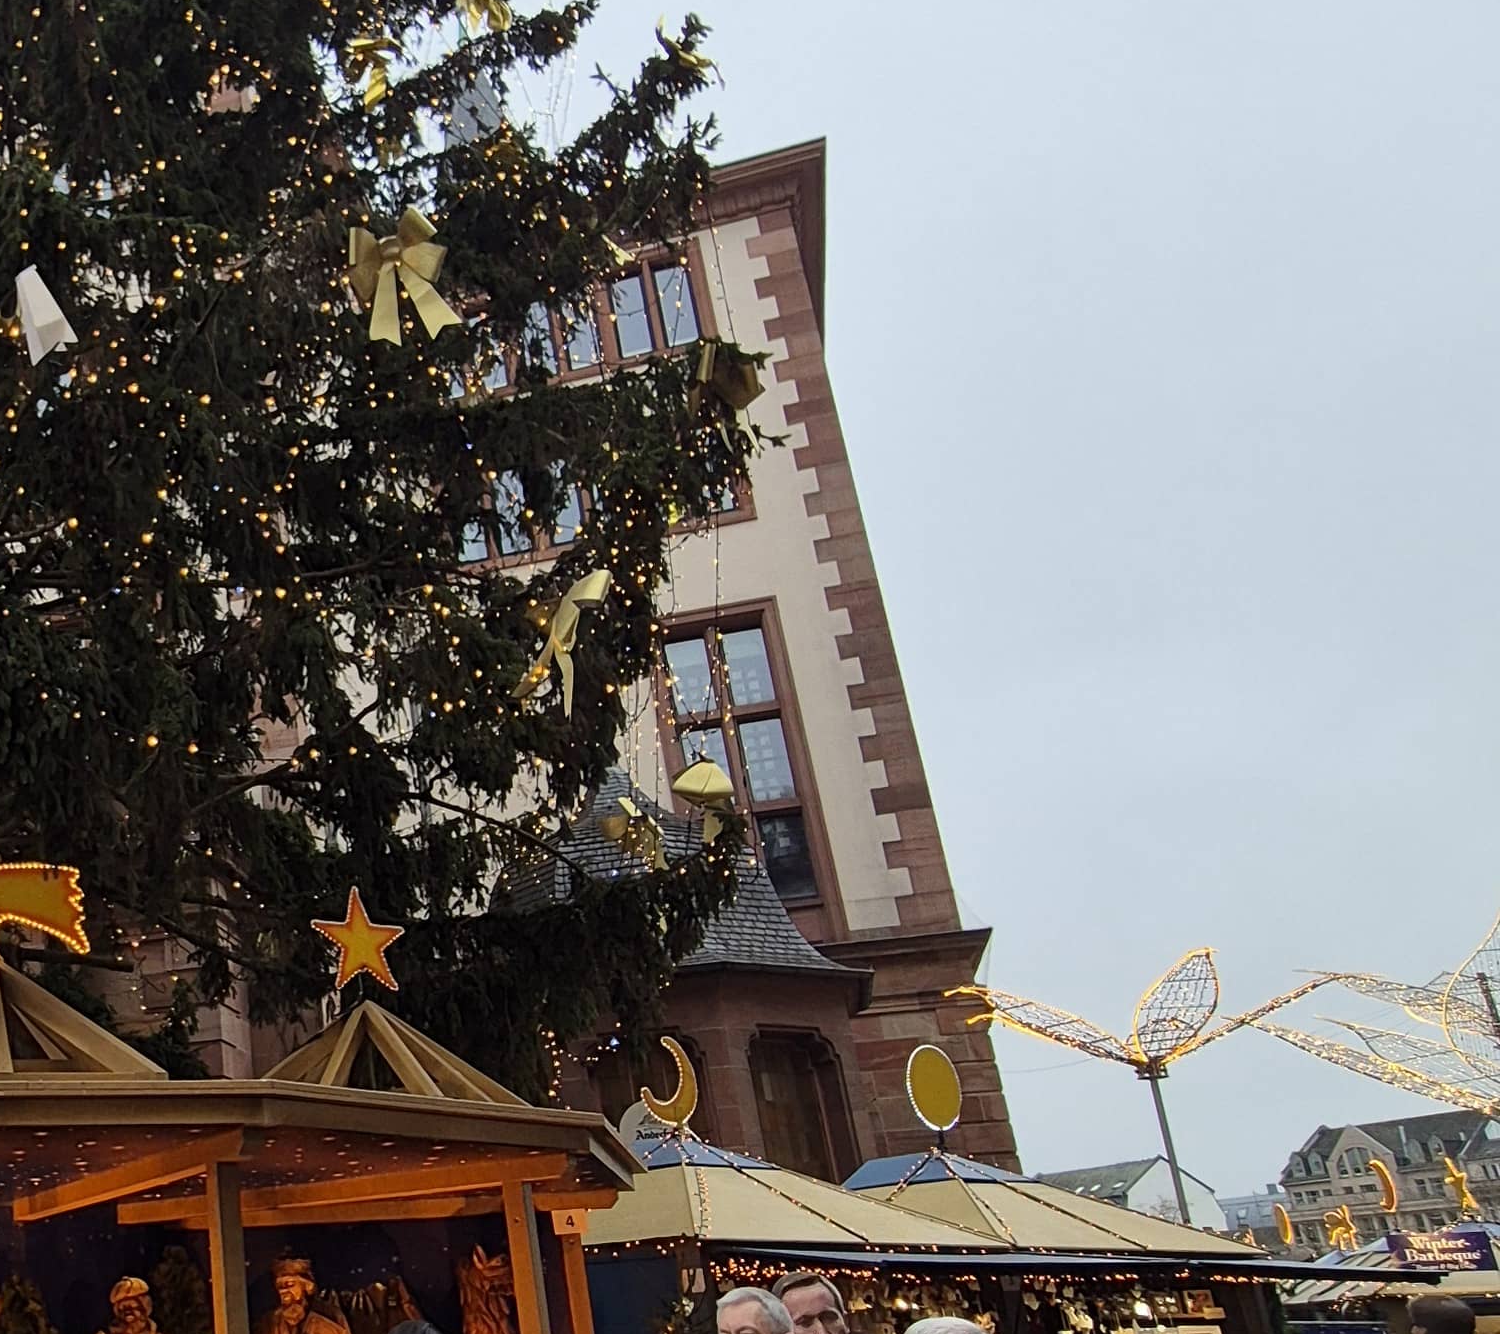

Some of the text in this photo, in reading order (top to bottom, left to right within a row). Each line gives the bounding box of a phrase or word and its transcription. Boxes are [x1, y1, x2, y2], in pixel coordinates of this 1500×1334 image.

[565, 1215, 575, 1227] 4
[1406, 1237, 1471, 1249] Winter-
[1404, 1248, 1481, 1264] Barbeque
